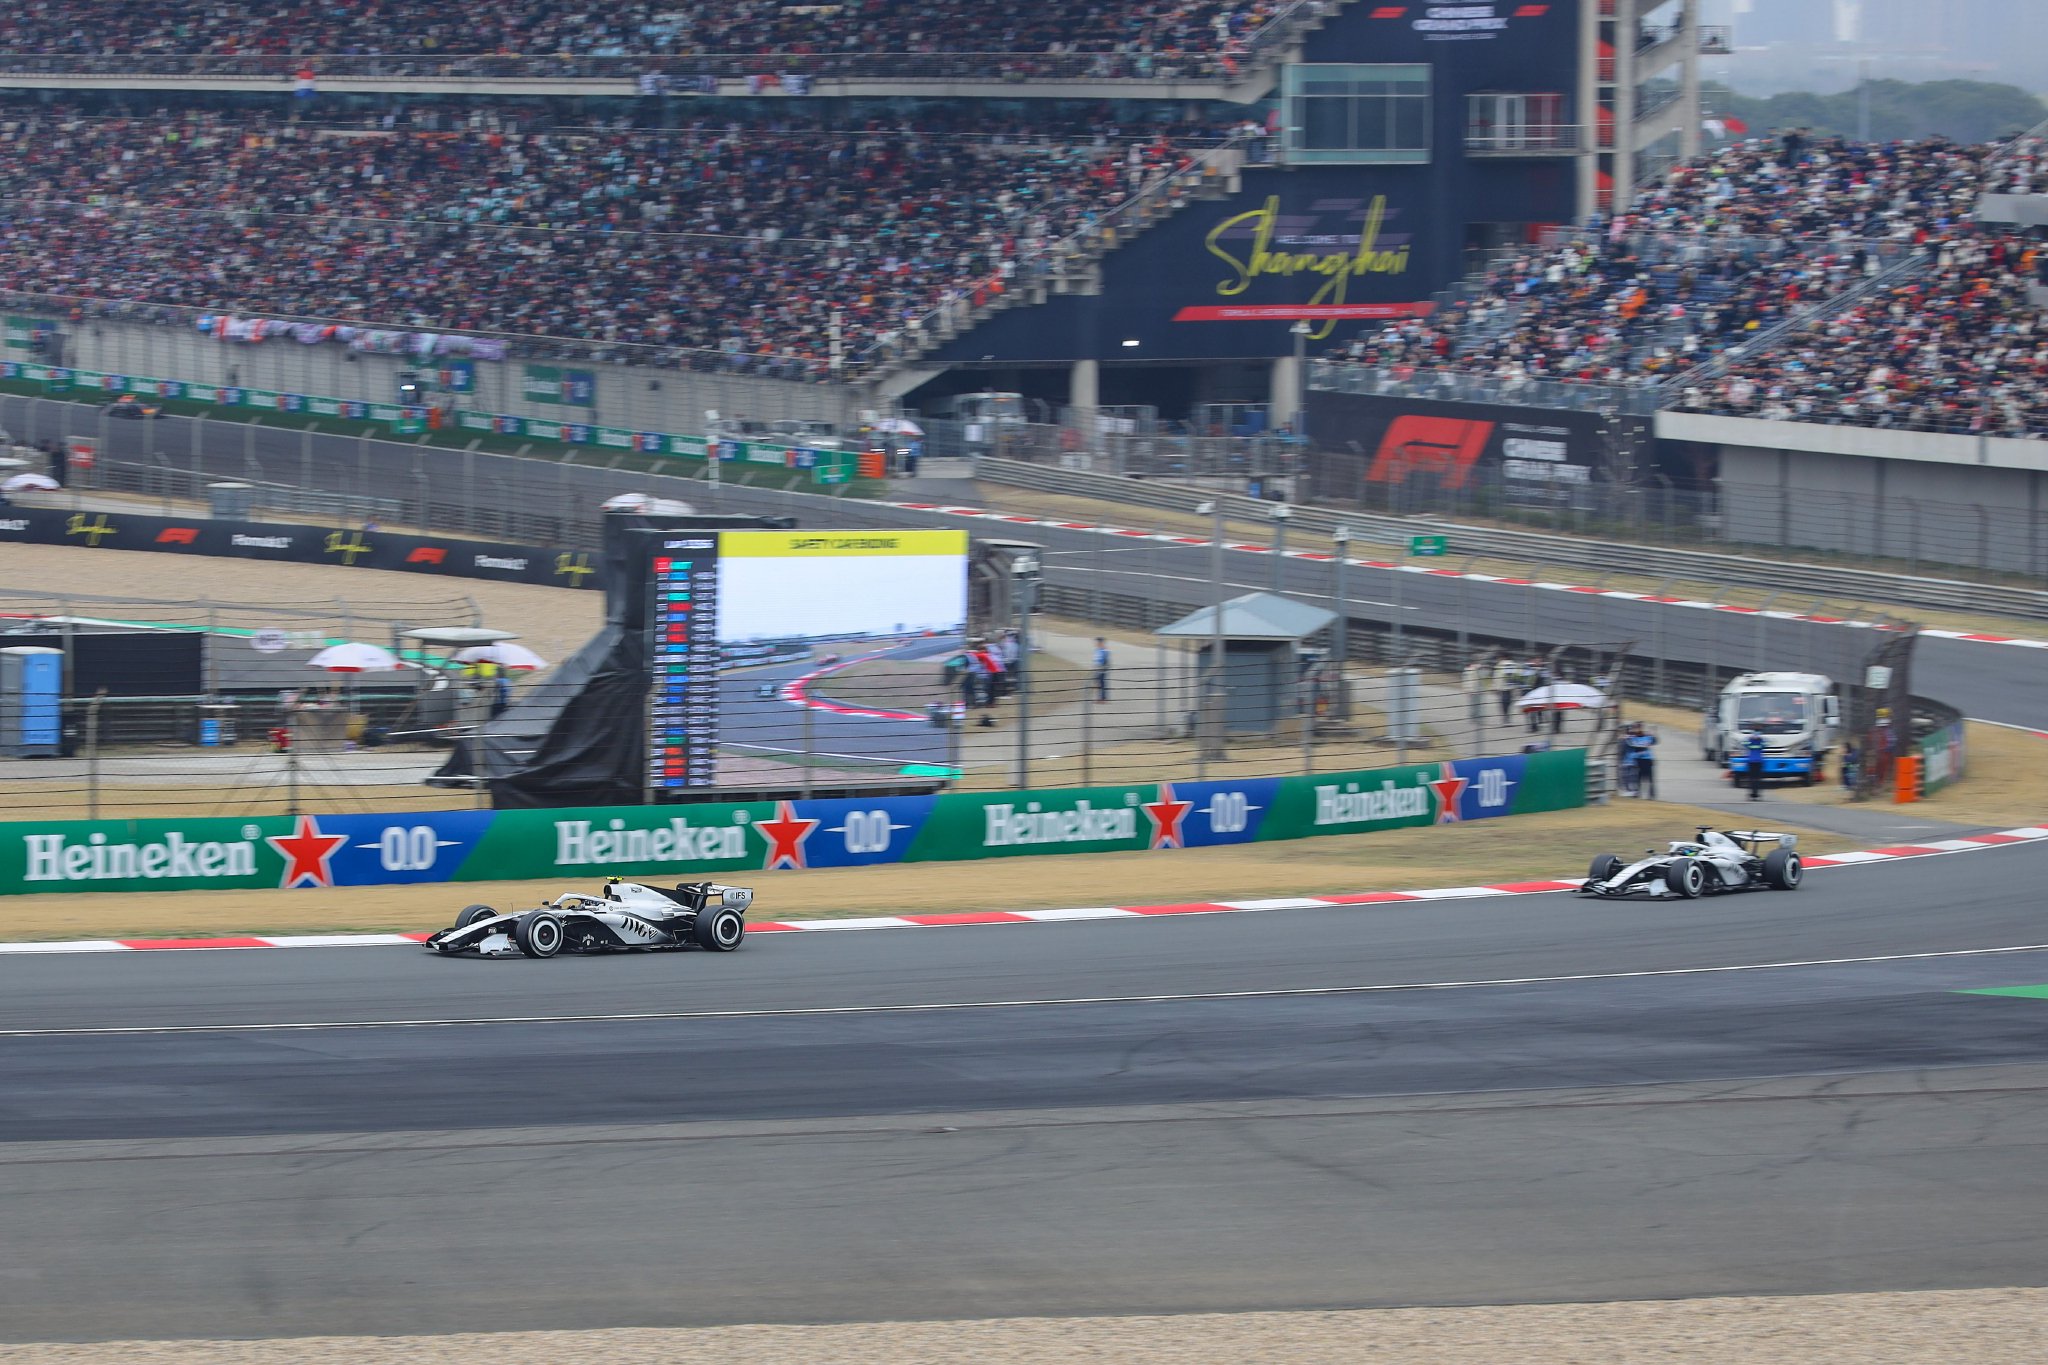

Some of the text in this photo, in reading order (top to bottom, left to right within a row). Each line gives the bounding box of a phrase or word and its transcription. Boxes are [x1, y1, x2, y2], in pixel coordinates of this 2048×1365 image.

[1205, 195, 1411, 339] Shanghai
[983, 800, 1138, 846] Heineken
[1314, 780, 1429, 825] Heineken
[22, 832, 259, 881] Heineken
[554, 818, 748, 864] Heineken
[735, 891, 746, 900] IFS
